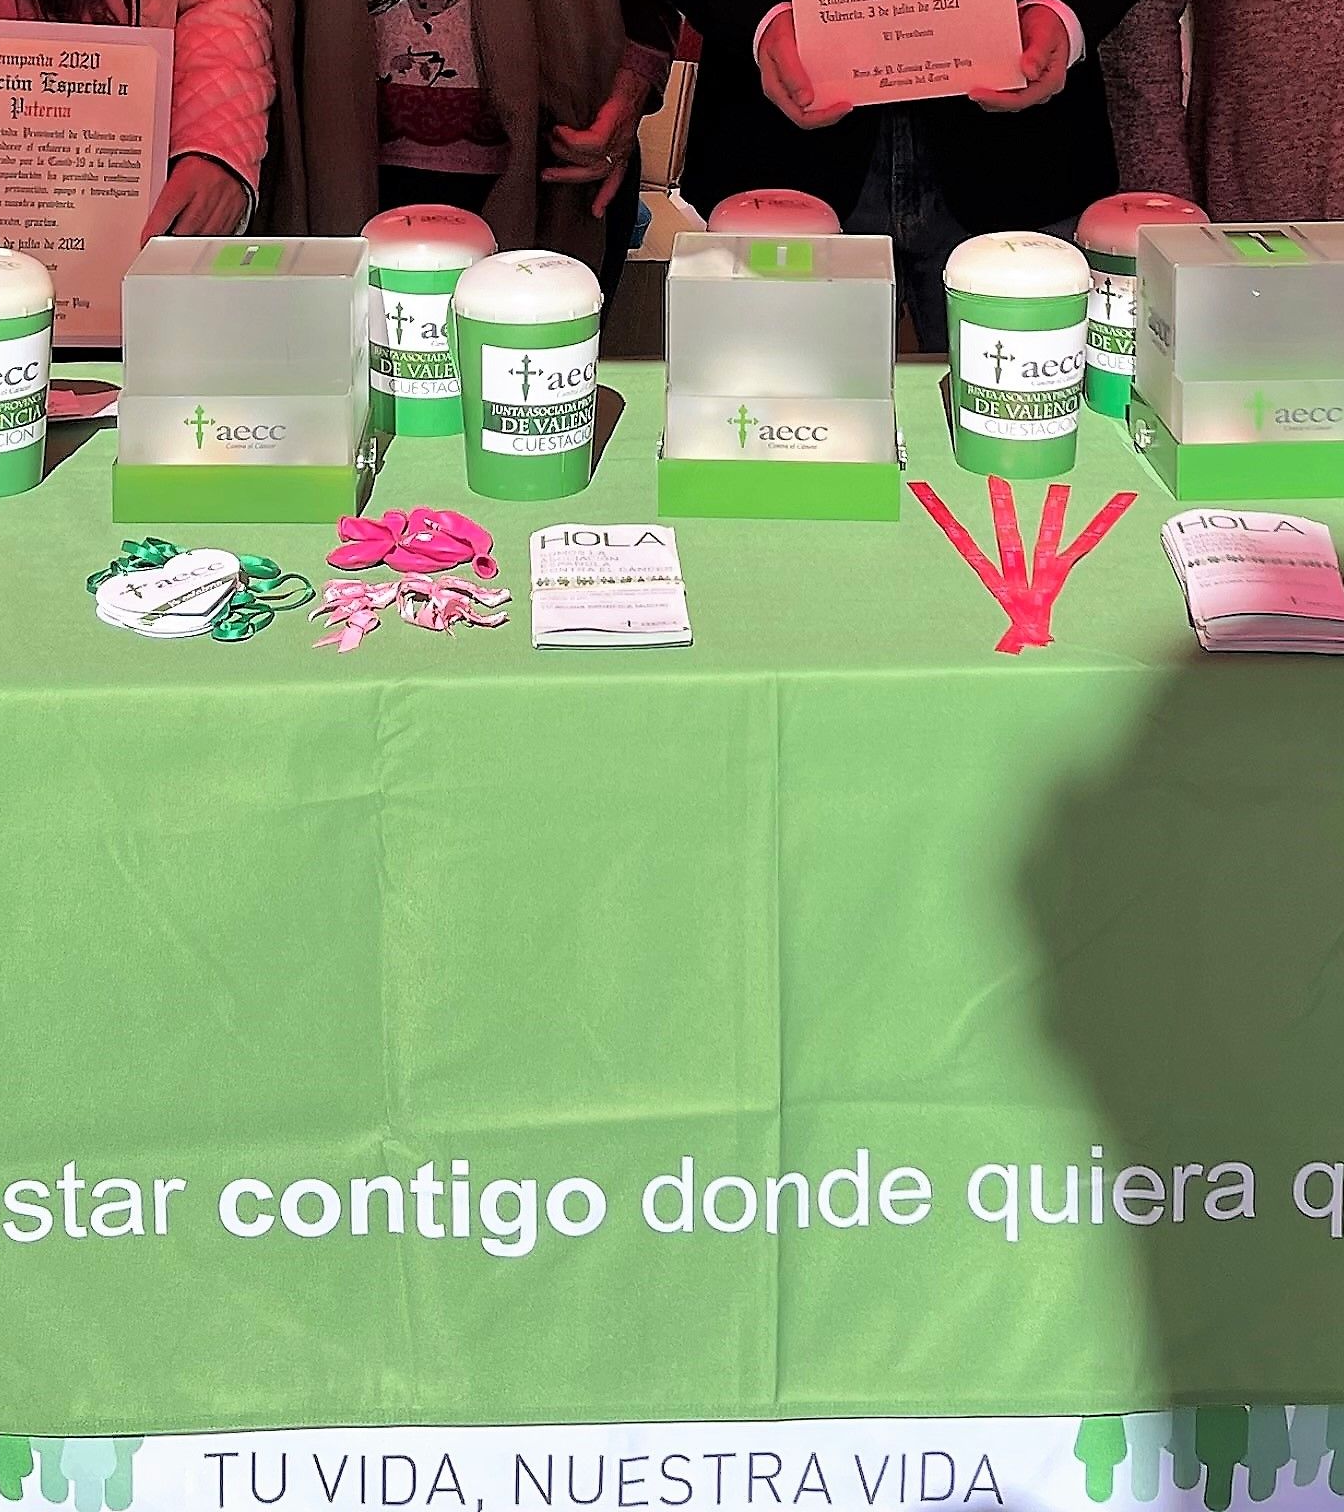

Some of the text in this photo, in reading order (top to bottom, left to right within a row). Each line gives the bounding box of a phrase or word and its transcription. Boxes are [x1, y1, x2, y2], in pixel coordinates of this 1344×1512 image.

[869, 6, 875, 19] 3
[878, 6, 889, 17] de
[917, 1, 930, 12] de
[58, 50, 101, 70] 2020
[40, 71, 112, 98] Especial
[117, 82, 129, 96] a
[10, 97, 71, 120] Paterna
[4, 236, 15, 249] de
[44, 238, 55, 250] de
[58, 237, 85, 250] 2021
[1091, 331, 1112, 352] DE
[380, 358, 402, 377] DE
[491, 404, 525, 417] JUNTA
[975, 398, 1000, 418] DE
[1275, 407, 1344, 424] aecc
[216, 425, 287, 441] aecc
[501, 417, 530, 435] DE
[759, 425, 829, 441] aecc
[1176, 514, 1306, 535] HOLA
[540, 531, 666, 549] HOLA
[218, 1159, 607, 1260] contigo
[641, 1147, 936, 1237] donde
[964, 1145, 1256, 1246] quiera
[203, 1451, 1005, 1511] TU VIDA, NUESTRA VIDA
